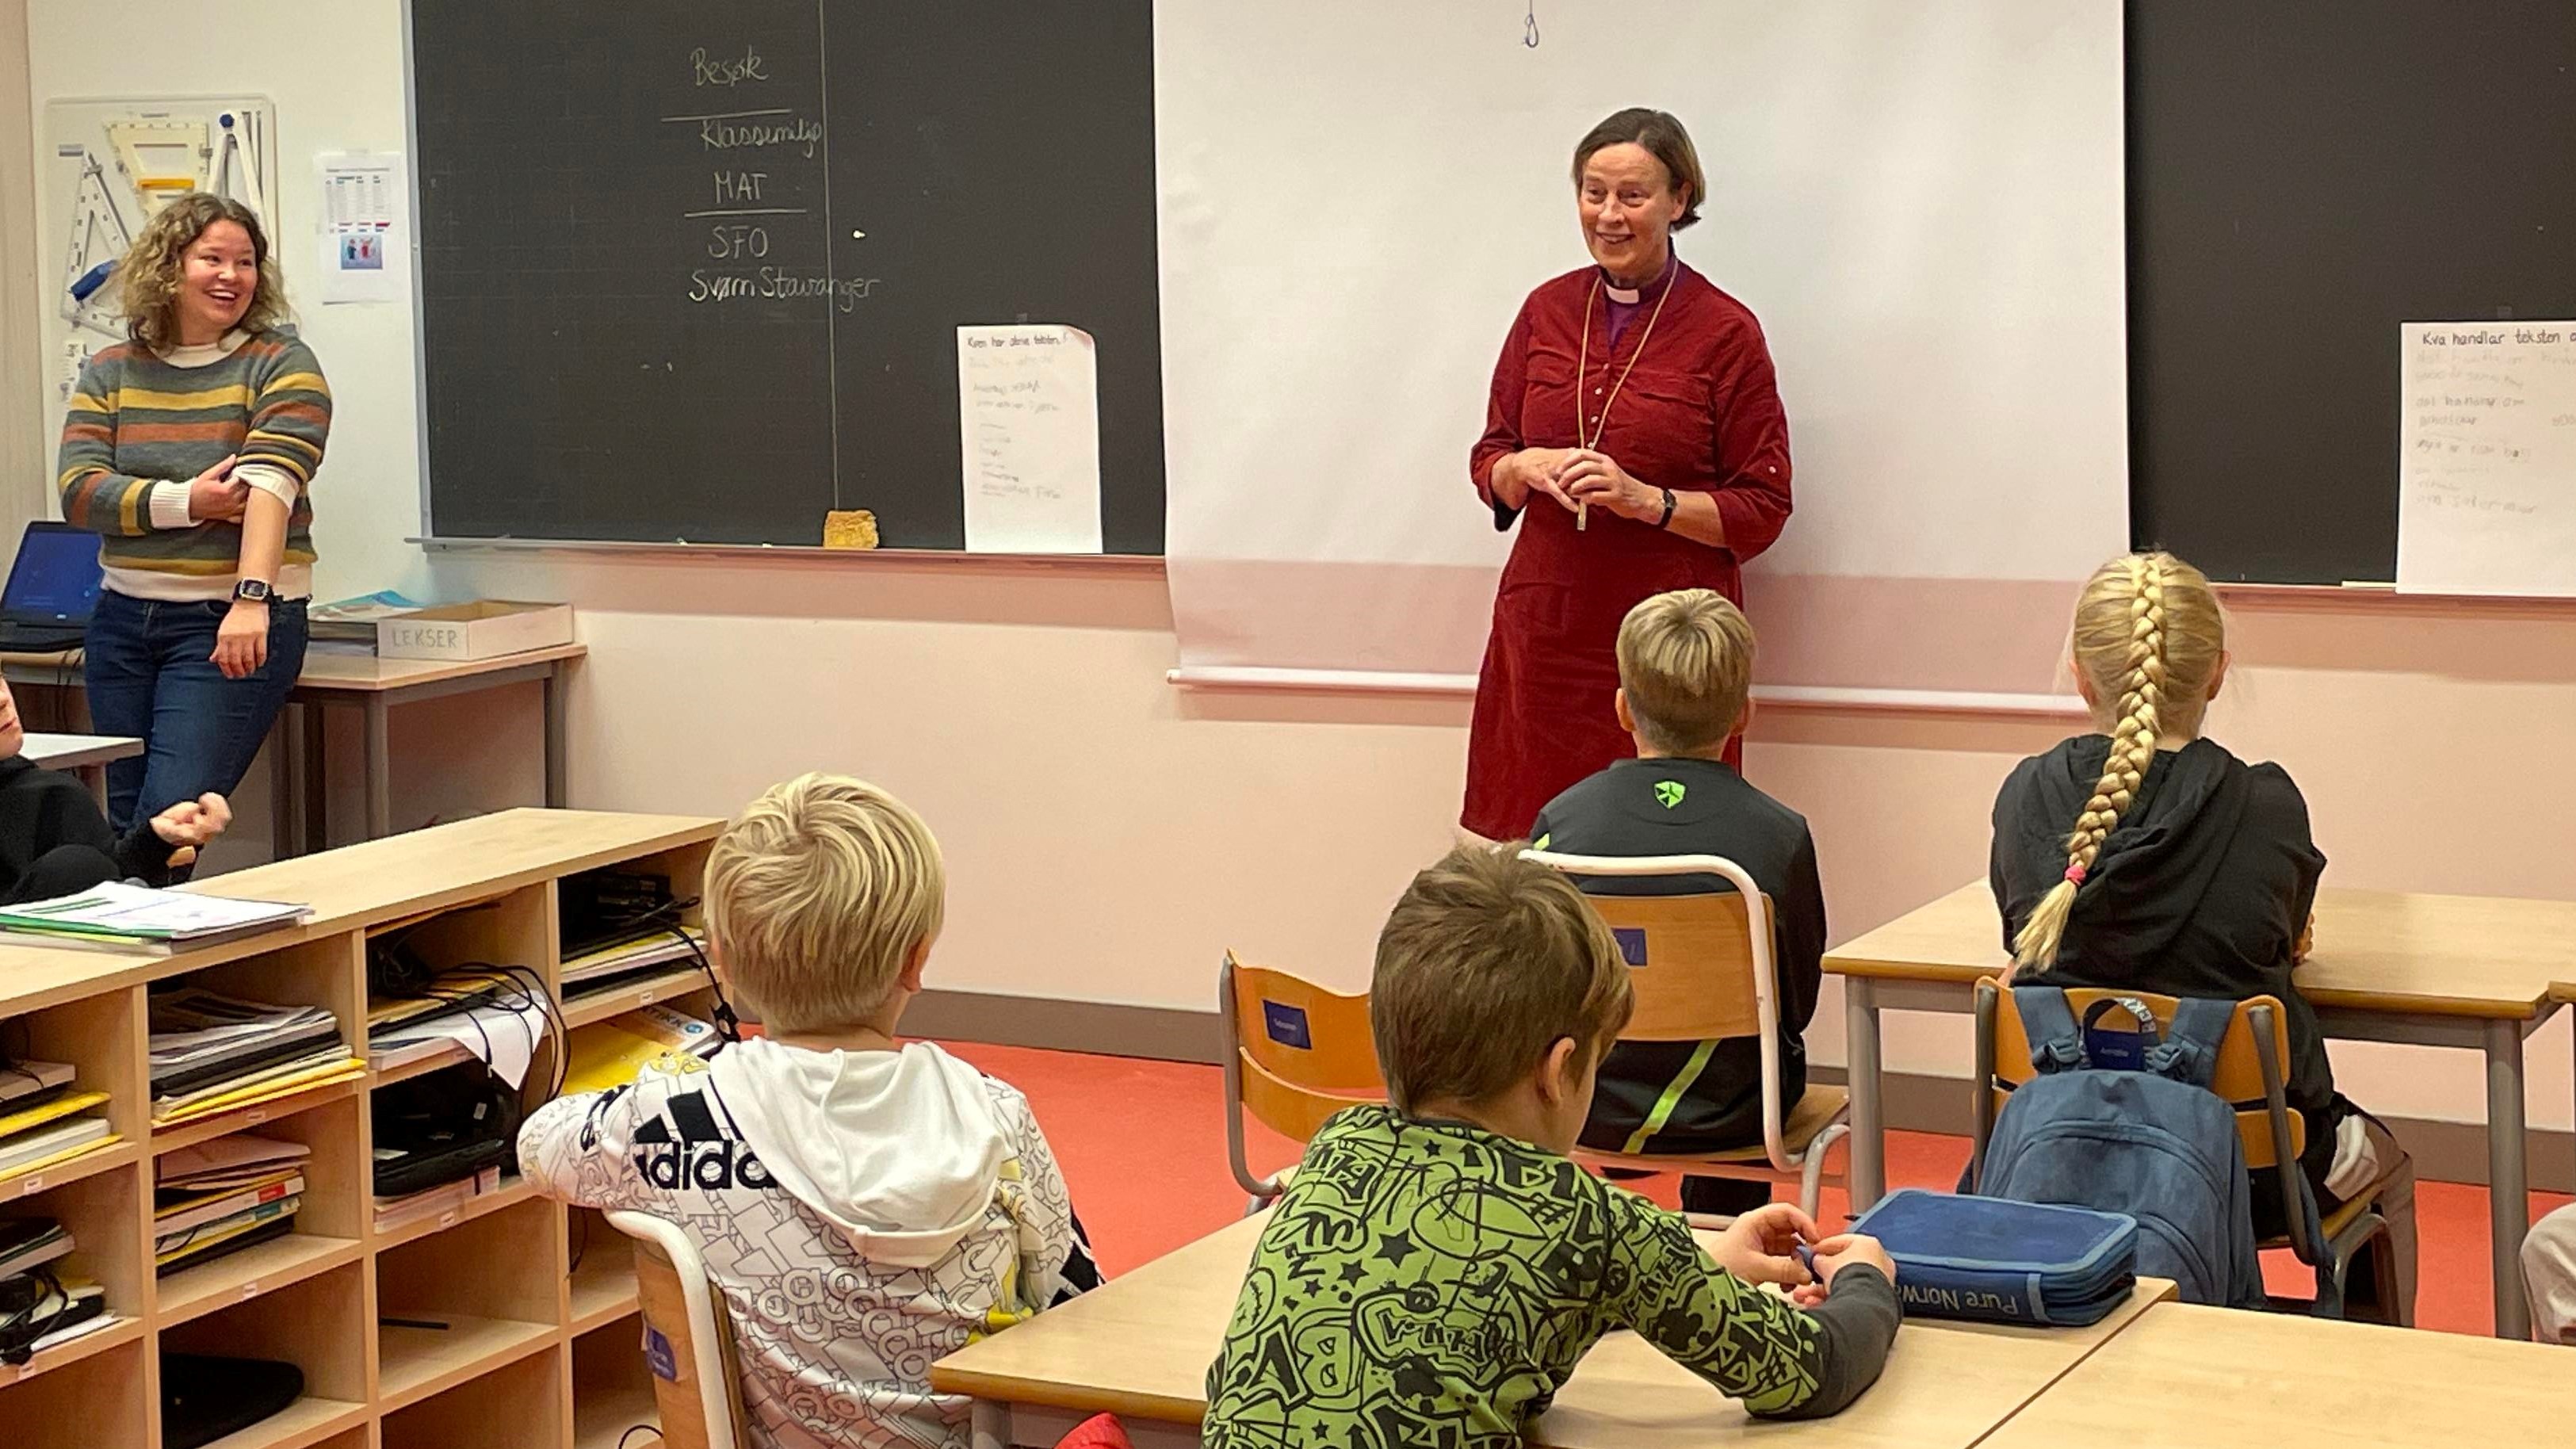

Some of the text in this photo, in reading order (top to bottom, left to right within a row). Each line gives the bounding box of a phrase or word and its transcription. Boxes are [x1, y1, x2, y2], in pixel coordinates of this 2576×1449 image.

[713, 170, 767, 204] MAT
[708, 225, 769, 259] SFO
[759, 266, 881, 313] Stavanger
[2423, 331, 2446, 346] Kva
[2452, 330, 2505, 345] handlar
[392, 629, 457, 648] LEKSER
[1965, 1290, 2019, 1316] Pure
